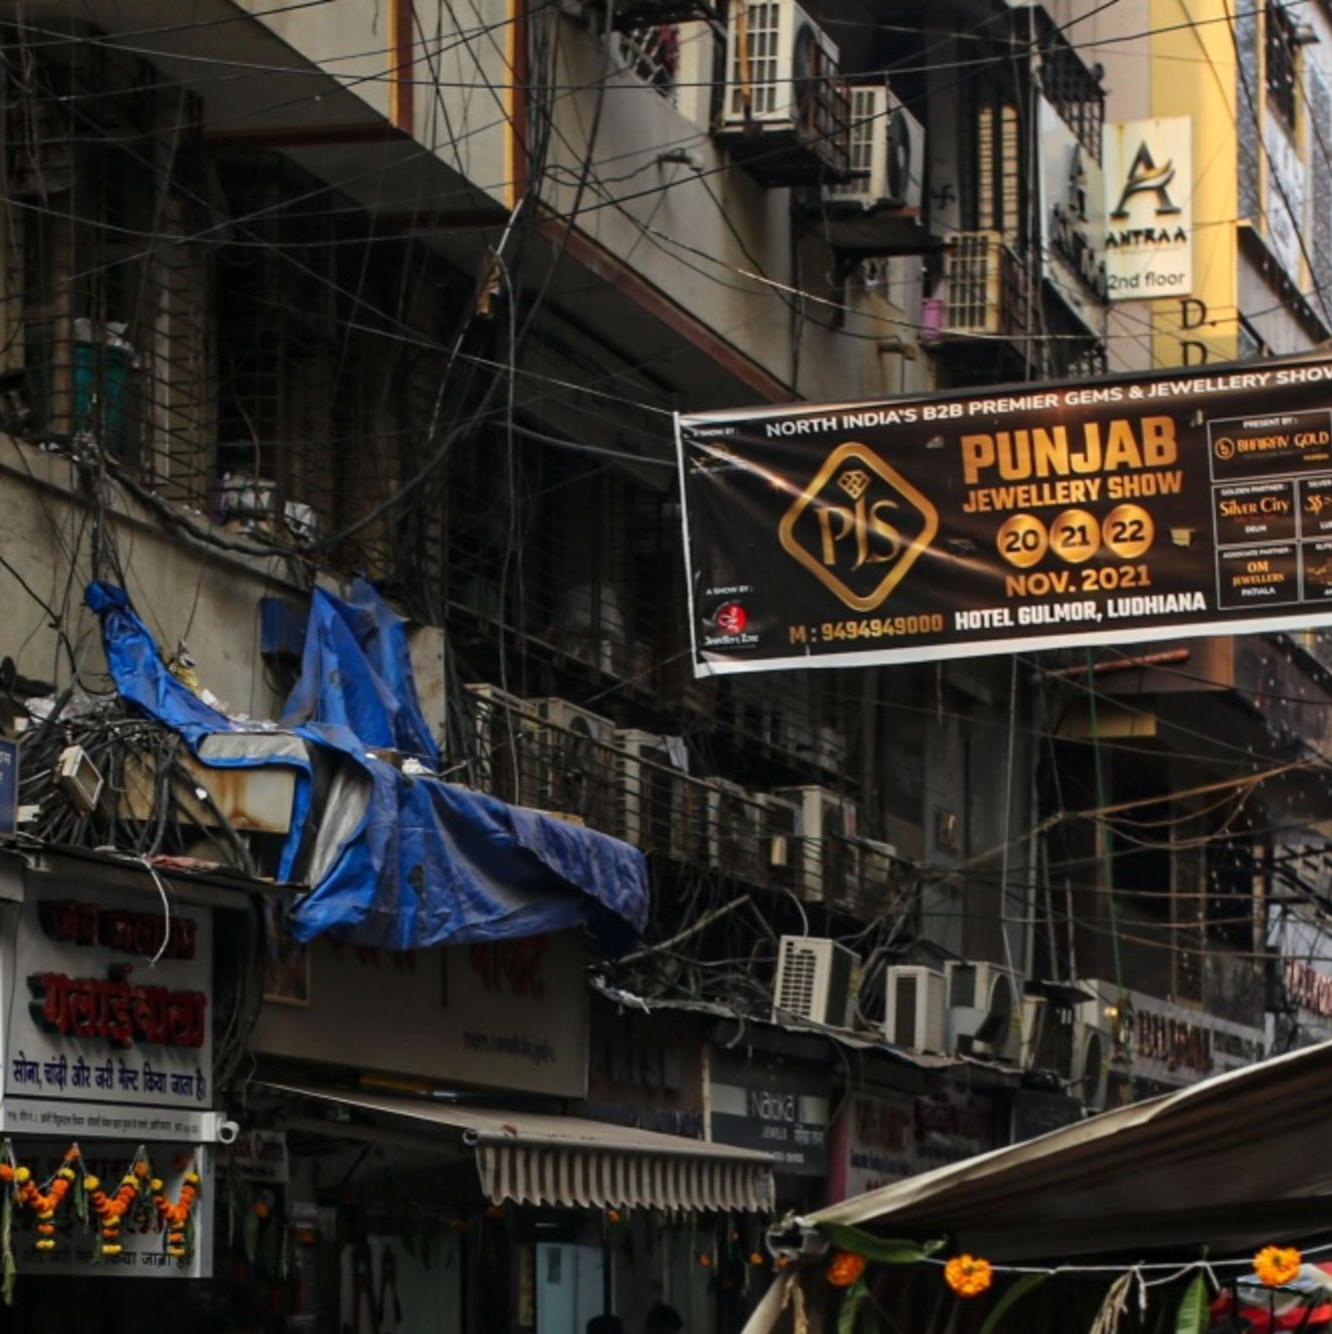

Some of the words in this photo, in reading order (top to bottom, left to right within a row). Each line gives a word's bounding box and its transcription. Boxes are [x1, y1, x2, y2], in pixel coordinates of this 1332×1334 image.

[1107, 273, 1140, 290] 2nd
[1145, 271, 1185, 288] floor
[766, 418, 837, 437] NORTH
[843, 409, 917, 431] INDIA'S
[923, 405, 964, 421] B2B
[969, 395, 1059, 416] PREMIER
[1065, 387, 1123, 407] GEMS
[1129, 385, 1144, 400] &
[1148, 372, 1269, 398] JEWELLERY
[1243, 418, 1279, 429] PRESENT
[961, 416, 1178, 484] PUNJAB
[1294, 431, 1330, 449] GOLD
[963, 476, 1101, 513] JEWELLERY
[1108, 471, 1183, 500] SHOW
[1005, 528, 1039, 553] 20
[1060, 525, 1090, 549] 21
[1112, 519, 1145, 543] 22
[1006, 571, 1076, 598] NOV.
[1082, 565, 1151, 592] 2021
[1233, 573, 1285, 587] JEWELLERS
[1247, 560, 1269, 574] OM
[1241, 587, 1276, 597] PATIALA
[955, 607, 1013, 631] HOTEL
[1018, 601, 1103, 627] GULMOR,
[1107, 591, 1207, 619] LUDHIANA
[789, 625, 806, 644] M
[821, 613, 943, 642] 9494949000
[71, 1056, 91, 1090] और
[143, 1062, 168, 1095] किया
[170, 1072, 194, 1098] जाता
